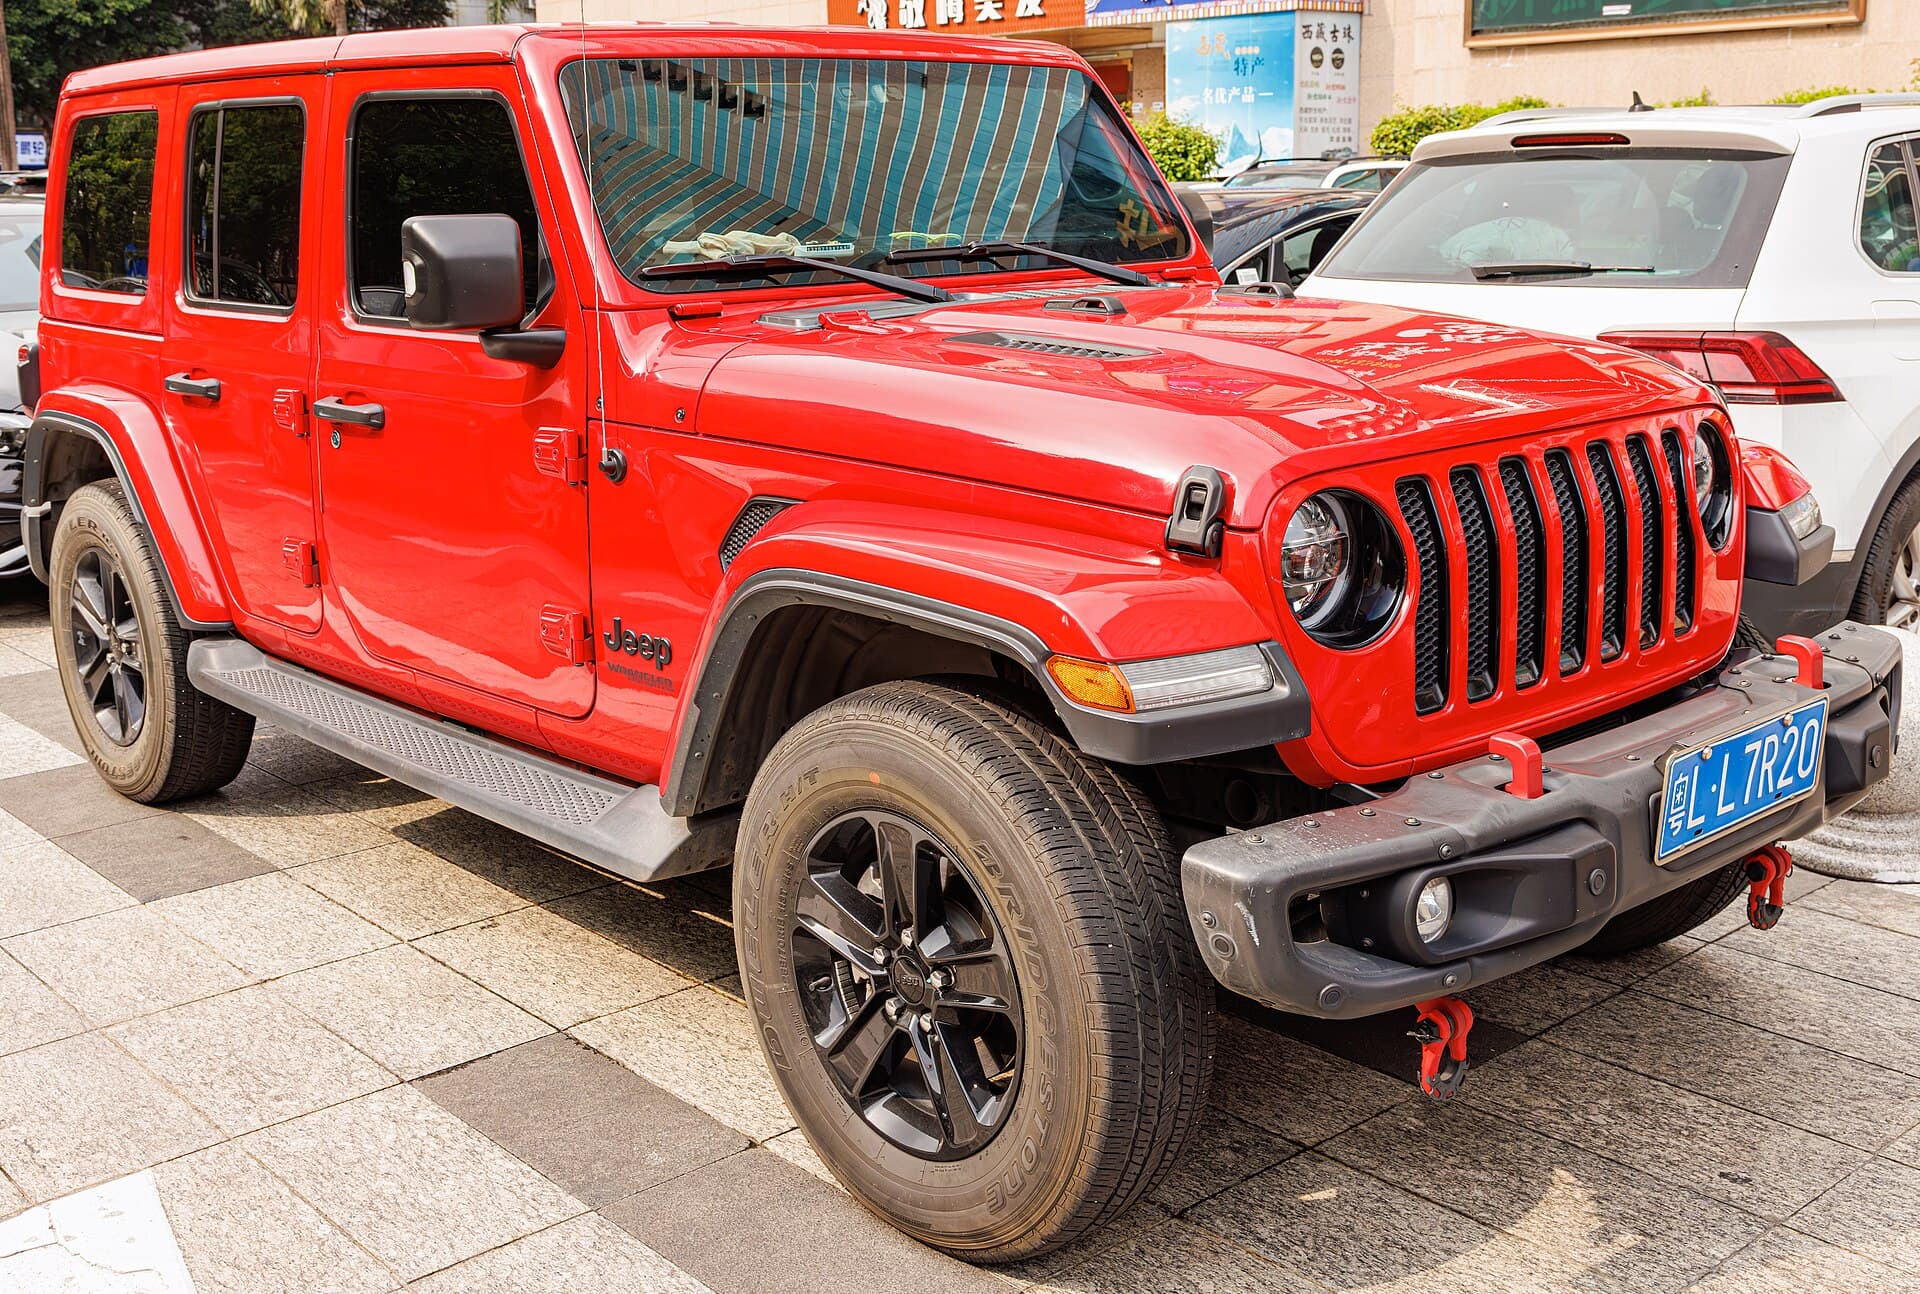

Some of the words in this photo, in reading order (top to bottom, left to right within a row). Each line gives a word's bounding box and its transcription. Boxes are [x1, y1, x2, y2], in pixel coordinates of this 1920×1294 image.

[1233, 56, 1264, 76] 特产
[1202, 86, 1255, 104] 名优产品
[603, 616, 672, 671] Jeep
[973, 839, 1059, 1215] BRIDGESTONE
